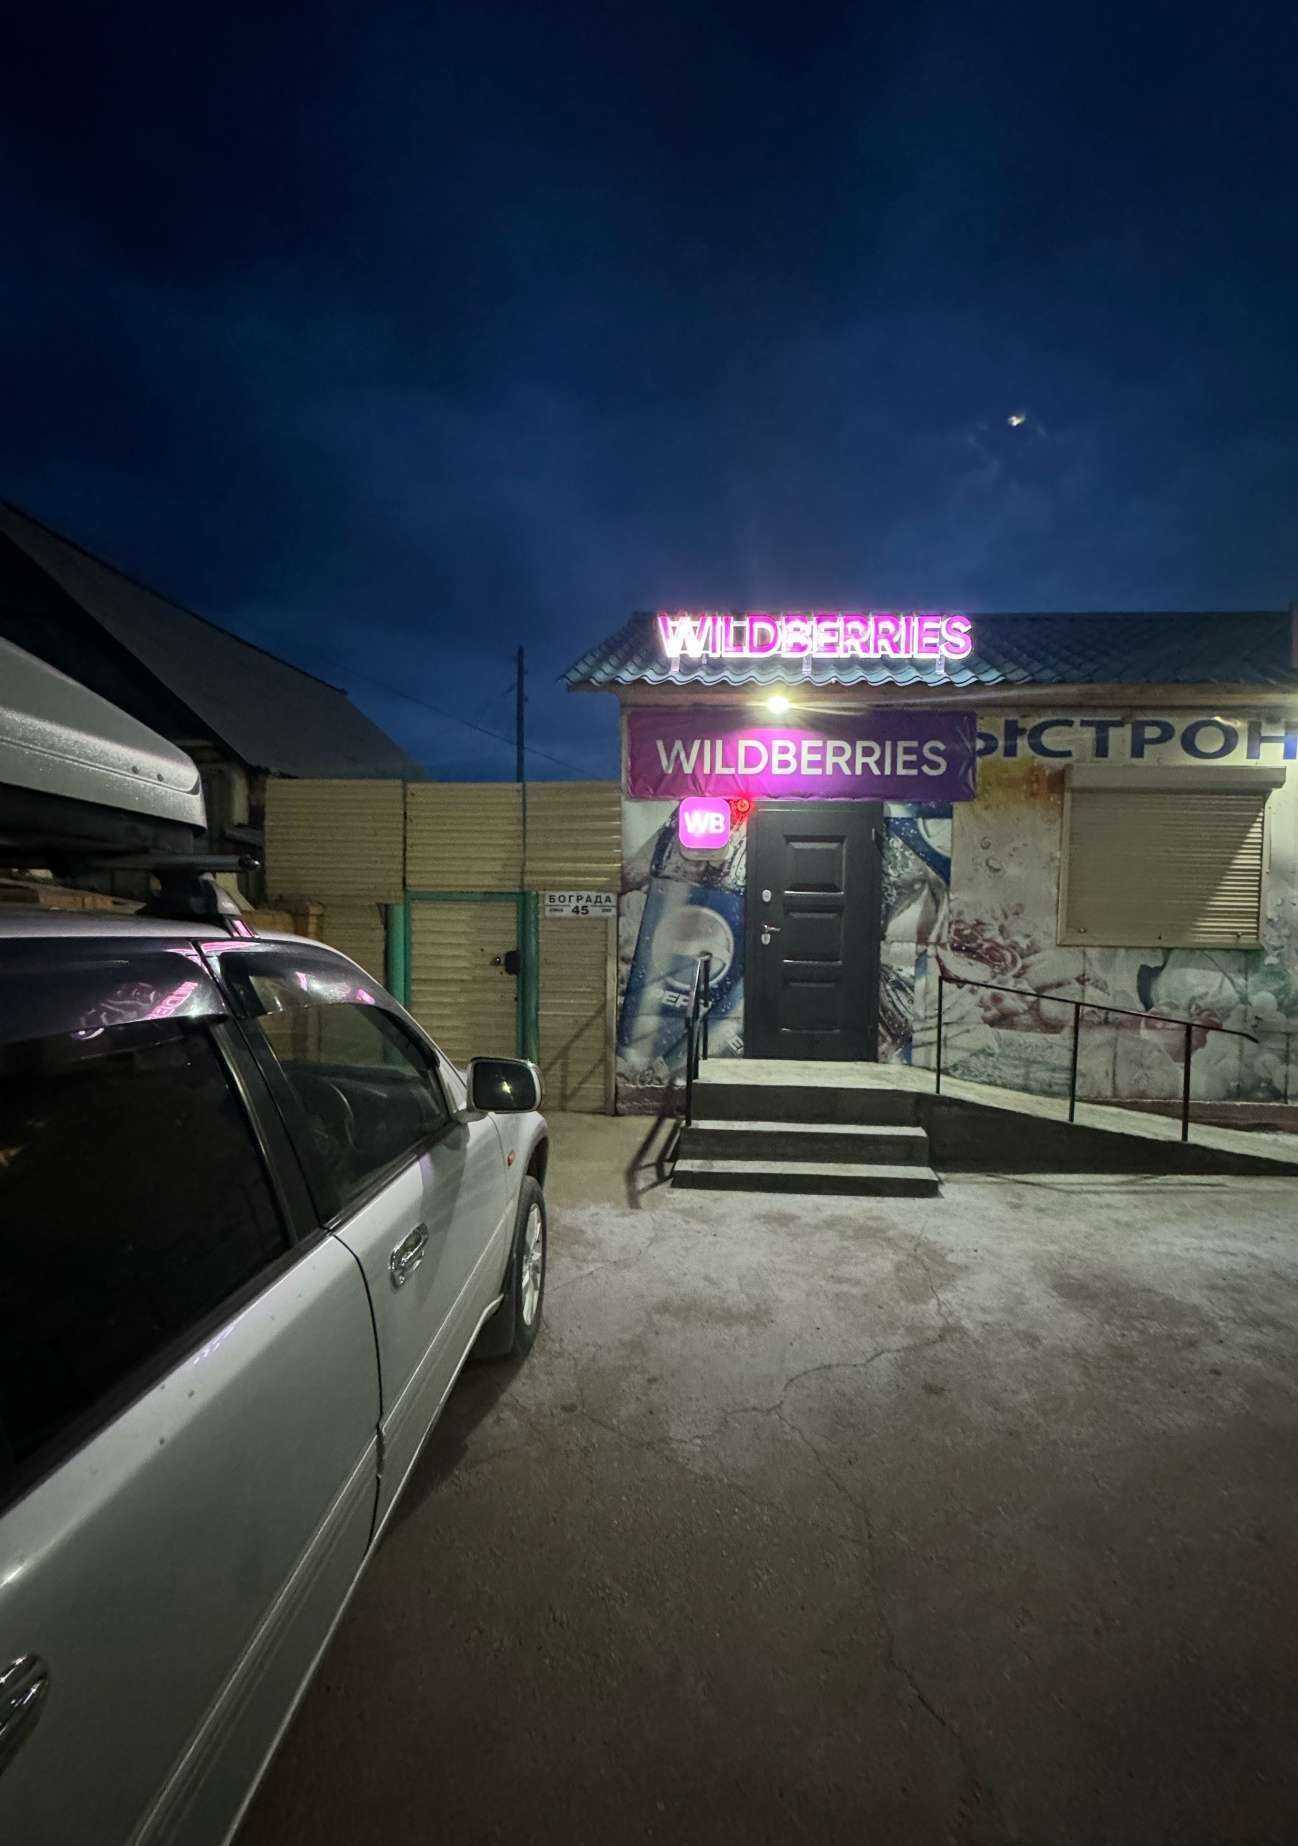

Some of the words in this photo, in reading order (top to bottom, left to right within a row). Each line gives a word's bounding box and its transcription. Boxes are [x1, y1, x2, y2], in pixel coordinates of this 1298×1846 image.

[657, 614, 974, 658] WILDBERRIES
[656, 739, 948, 776] WILDBERRIES
[684, 810, 726, 834] WB
[549, 894, 612, 905] БОГРАДА
[571, 905, 590, 916] 45
